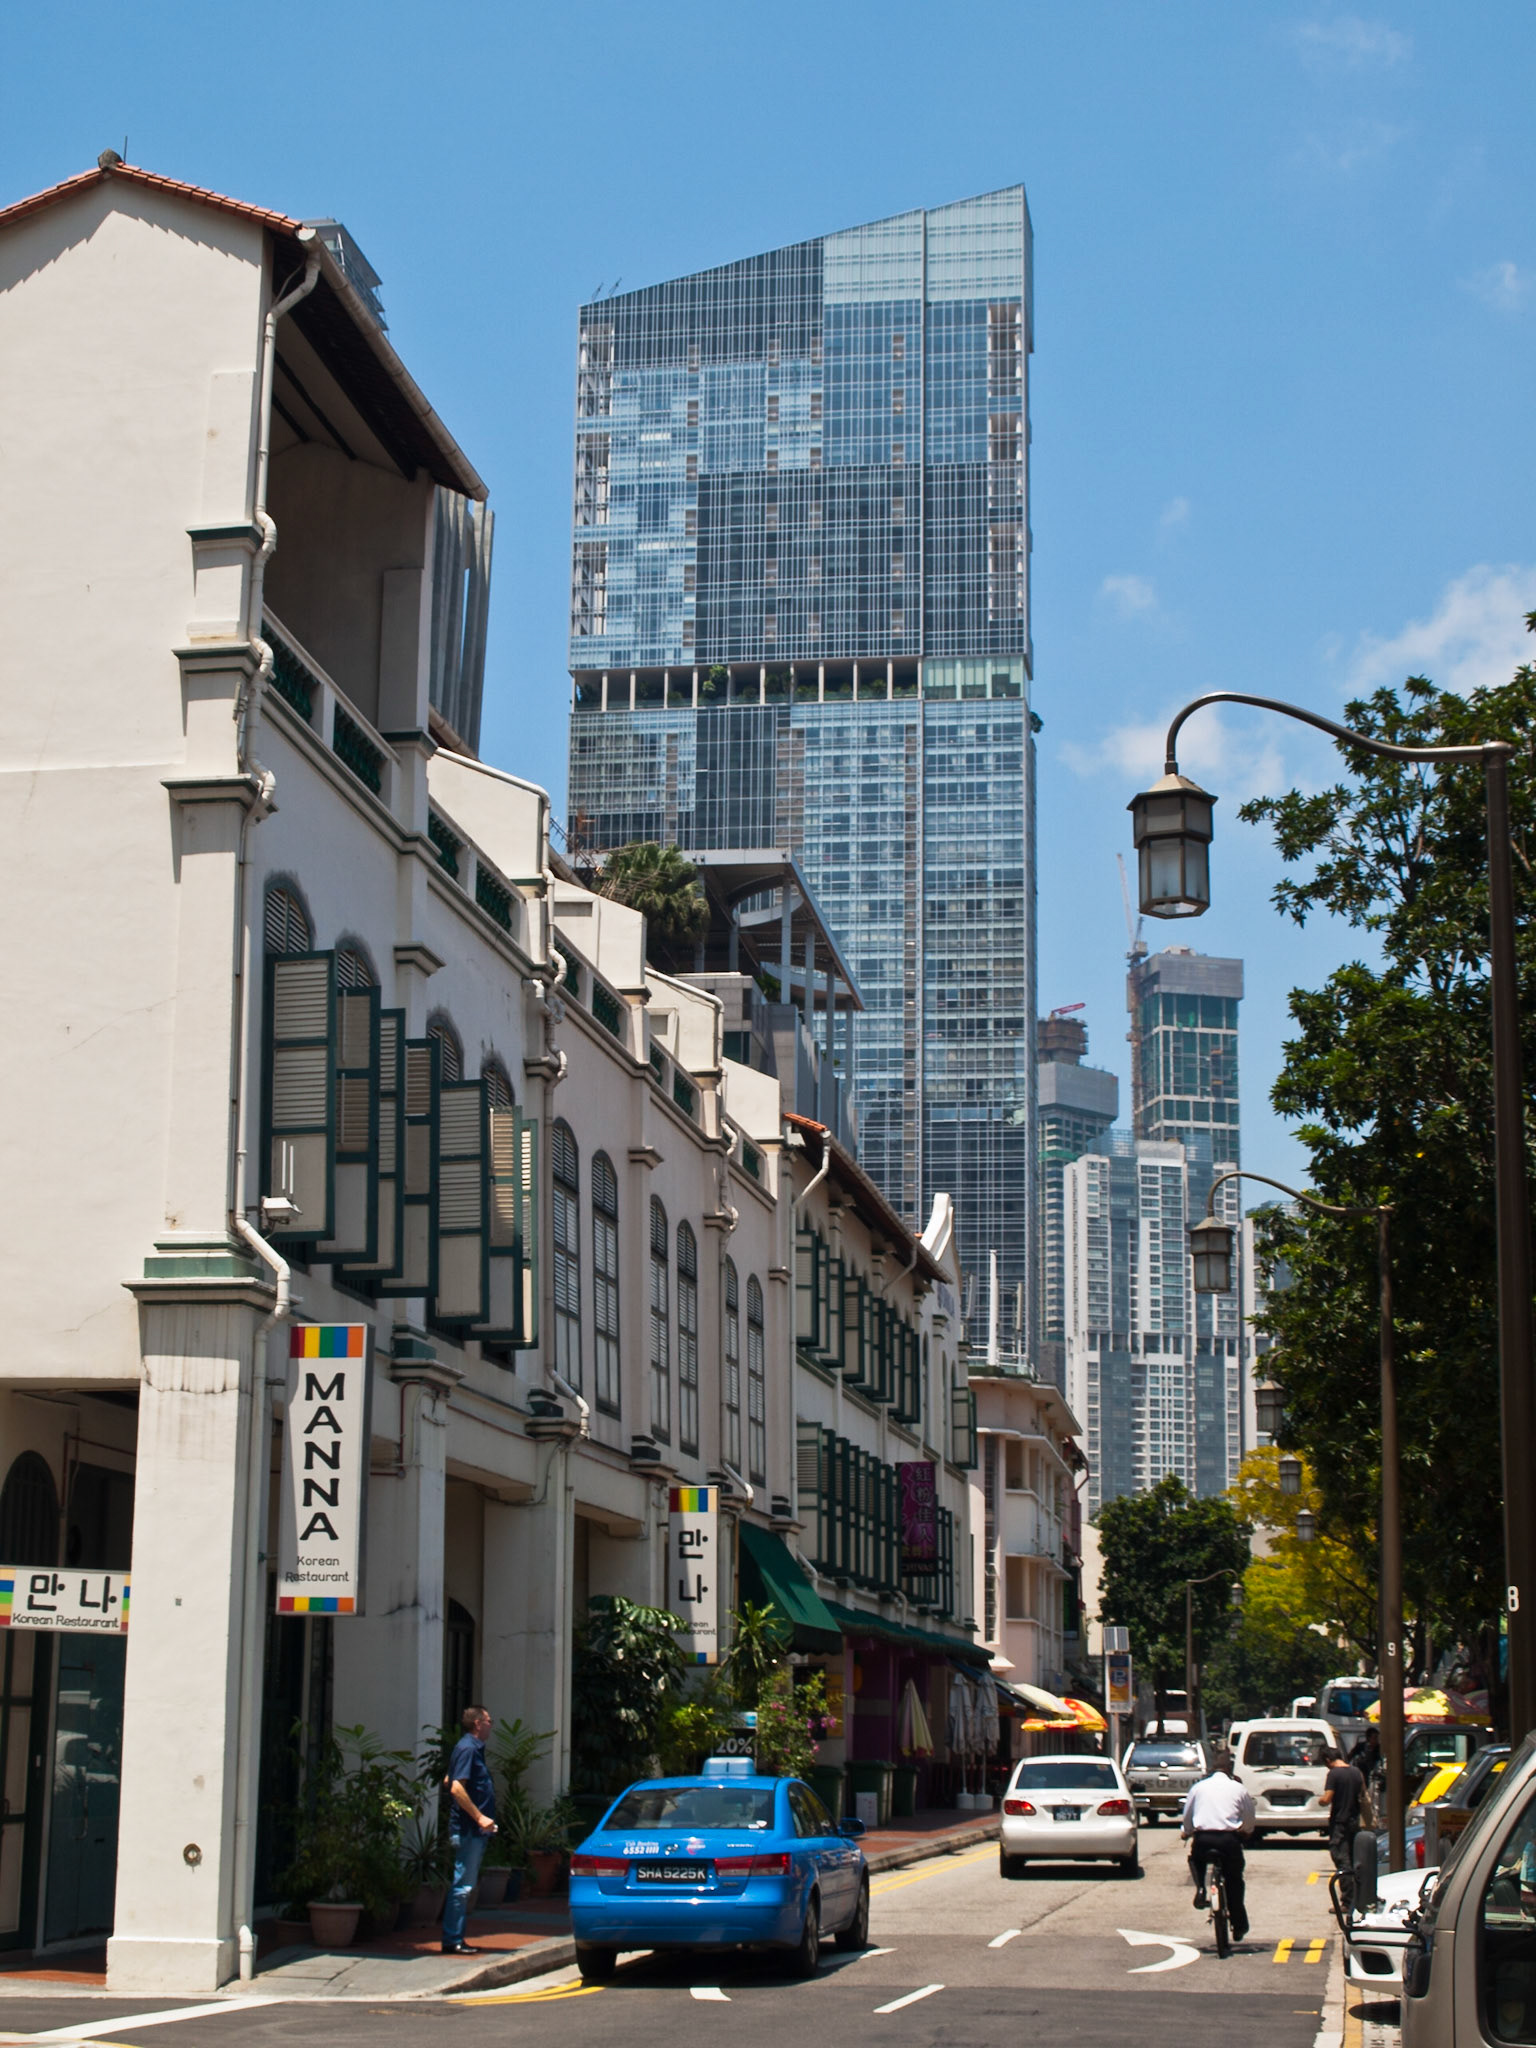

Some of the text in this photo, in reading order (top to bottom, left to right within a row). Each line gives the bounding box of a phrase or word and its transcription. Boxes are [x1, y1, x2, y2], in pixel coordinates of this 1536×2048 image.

[299, 1372, 346, 1541] MANNA
[296, 1556, 340, 1567] Korean
[678, 1528, 709, 1604] 만나
[285, 1571, 350, 1583] Restaurant
[27, 1573, 118, 1614] 만나
[1507, 1585, 1520, 1612] 8
[12, 1613, 120, 1629] Korean Restaurant
[1387, 1642, 1396, 1656] 9
